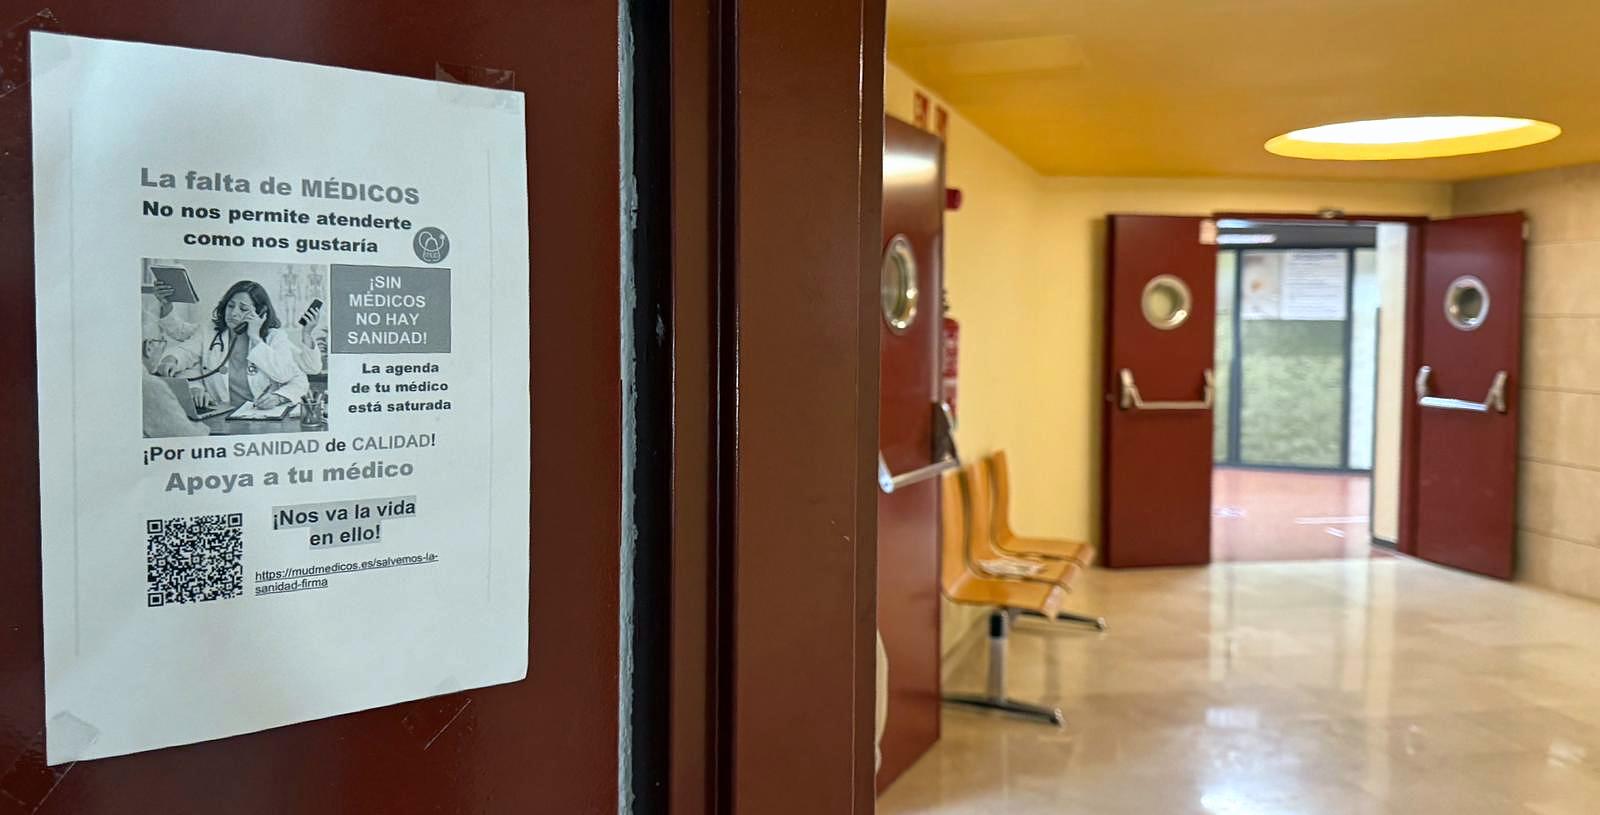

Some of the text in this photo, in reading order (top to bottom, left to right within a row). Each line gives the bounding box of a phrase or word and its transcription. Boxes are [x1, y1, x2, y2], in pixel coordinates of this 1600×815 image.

[141, 167, 419, 204] La falta de MÉDICOS
[143, 201, 411, 230] No nos permite atenderte
[184, 233, 378, 253] como nos gustaría
[370, 276, 401, 291] ¡SIN
[349, 290, 425, 308] MÉDICOS
[356, 313, 419, 326] NO HAY
[348, 331, 427, 345] SANIDAD!
[362, 363, 439, 376] La agenda
[351, 380, 448, 393] de tu médico
[348, 399, 451, 413] está saturada
[144, 433, 436, 465] ¡Por una SANIDAD de CALIDAD!
[166, 461, 413, 495] Apoya a tu médico
[273, 500, 415, 530] ¡Nos va la vida
[310, 524, 380, 546] en ello!
[255, 552, 438, 582] https://mudmedicos.es/salvemos-la-
[255, 577, 328, 595] sanidad-firma
